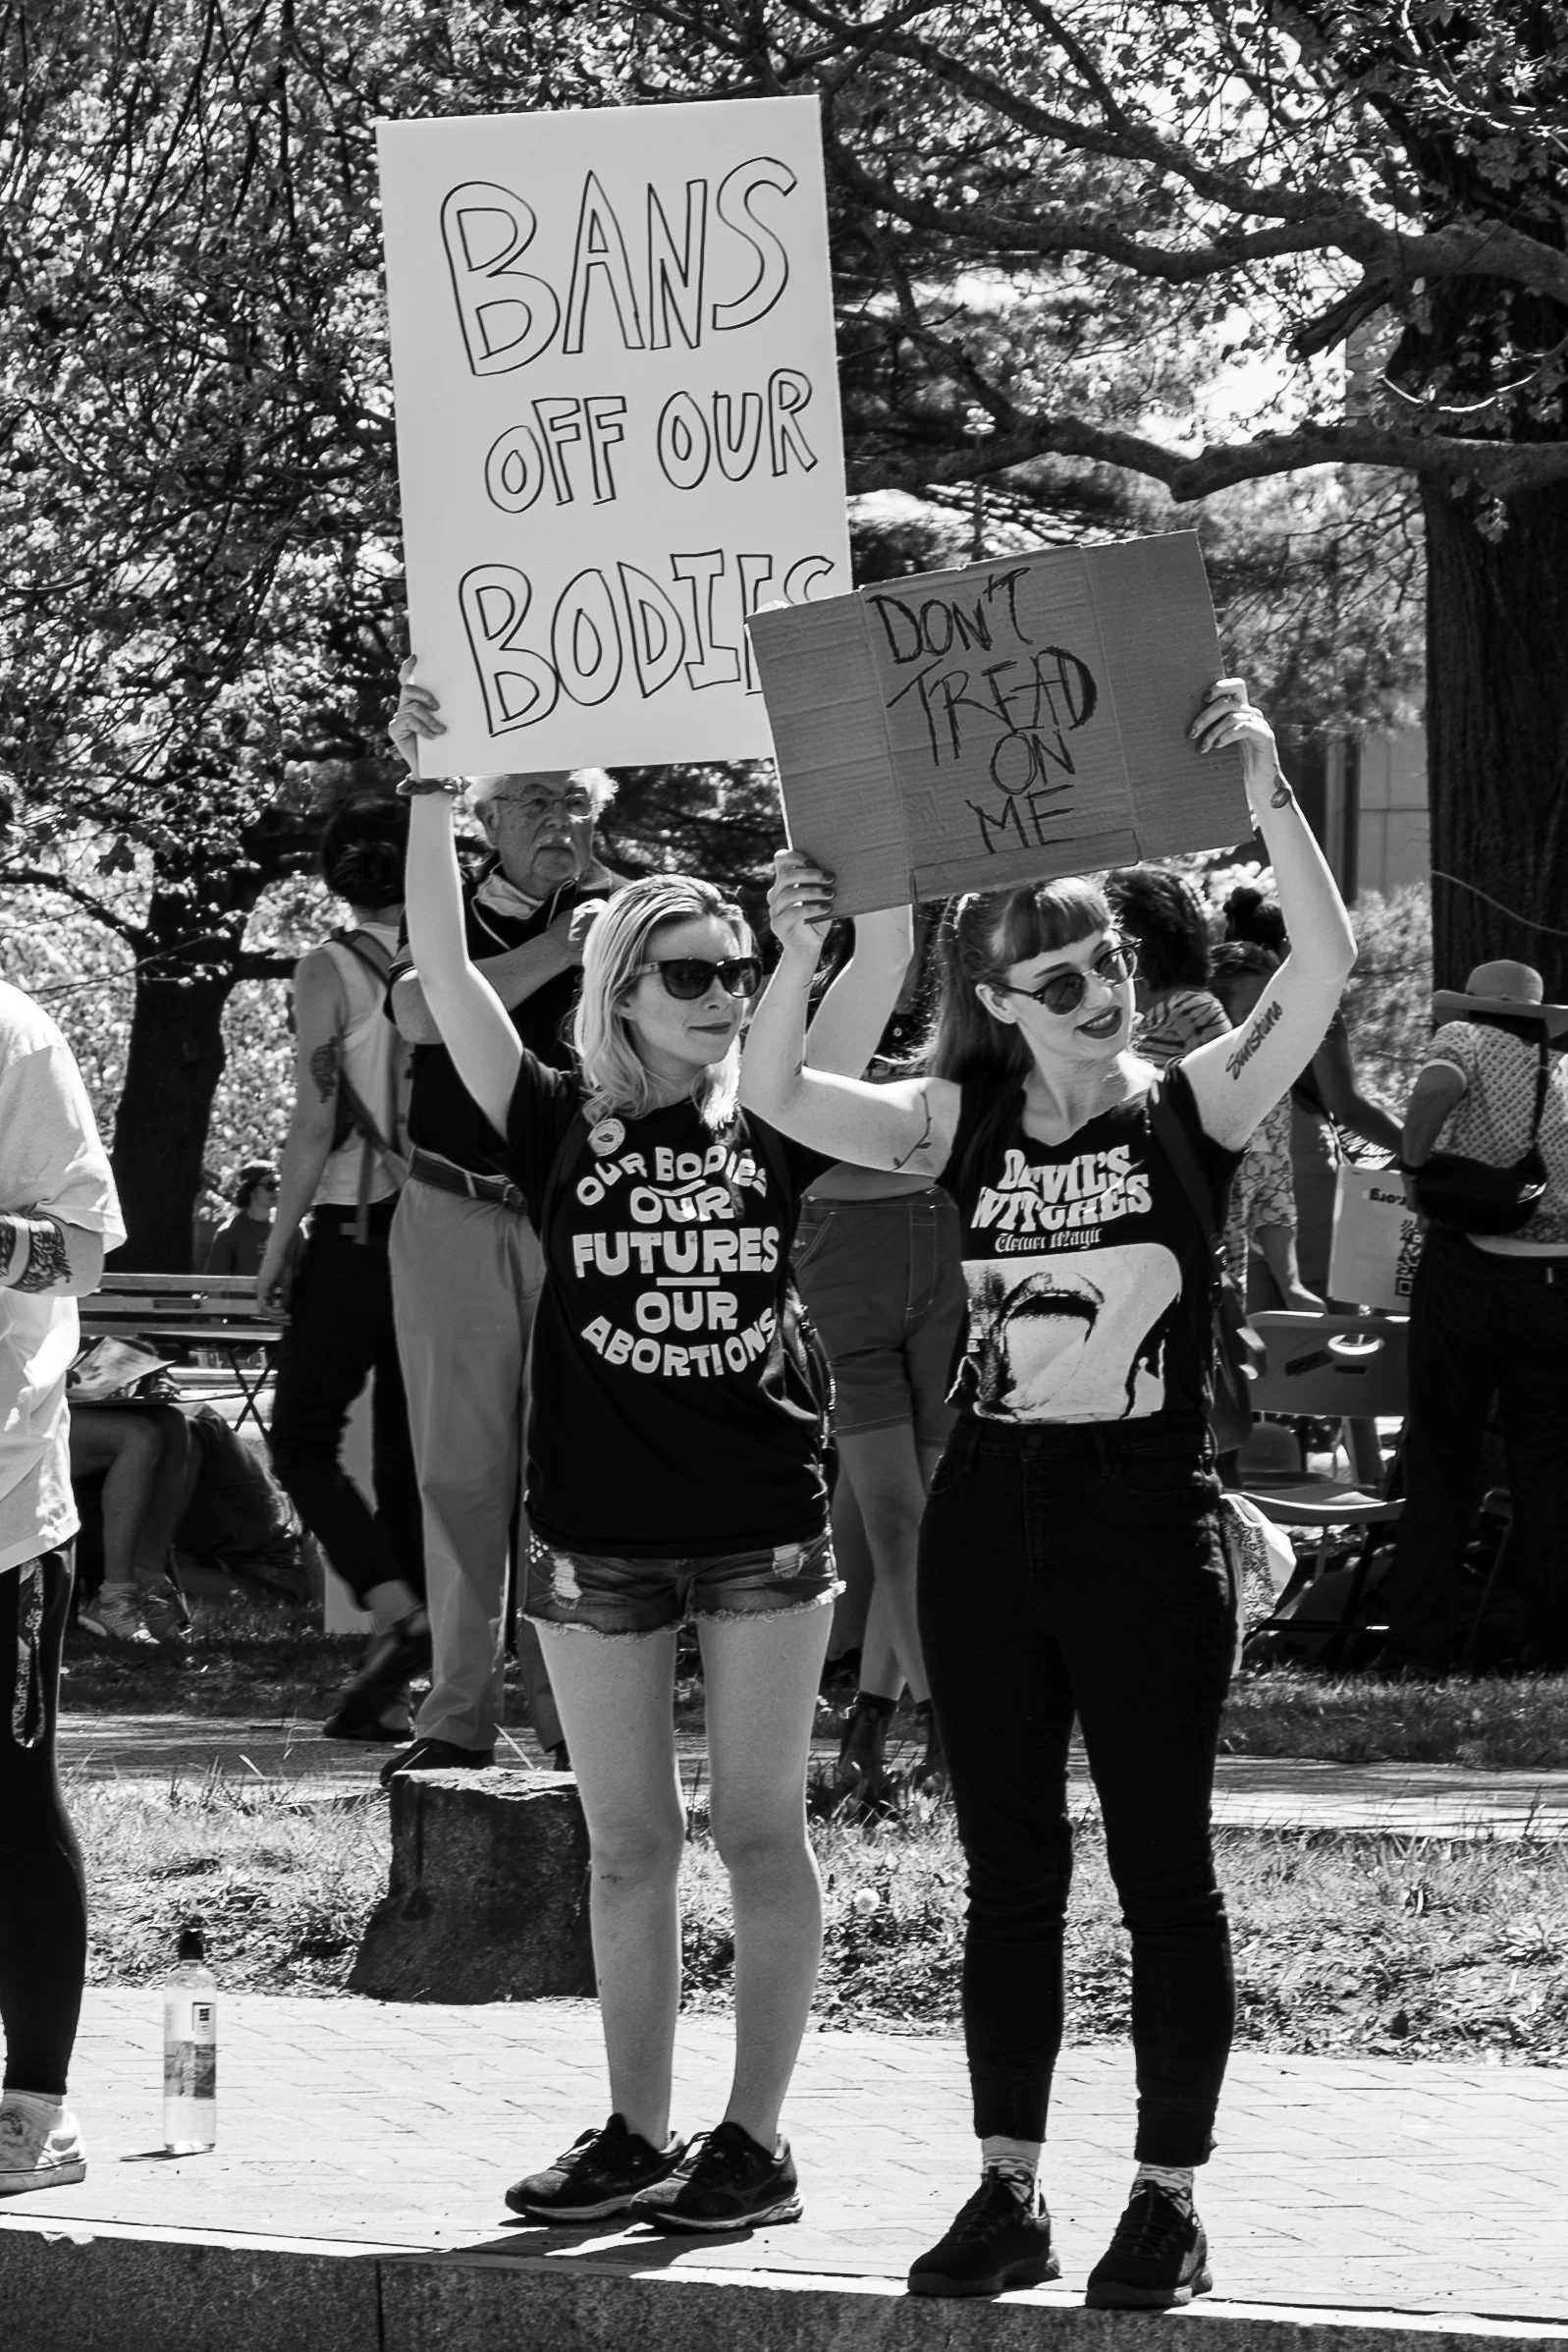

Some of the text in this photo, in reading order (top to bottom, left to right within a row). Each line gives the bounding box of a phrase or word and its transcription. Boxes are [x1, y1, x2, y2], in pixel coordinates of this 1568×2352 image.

[440, 156, 797, 376] BANS
[485, 368, 817, 514] OFF OUR
[865, 567, 1033, 665] DON'T
[886, 645, 1099, 767] TREAD
[990, 728, 1076, 795] ON
[964, 784, 1076, 854] ME
[576, 1145, 767, 1206] OUR BODIES
[630, 1185, 735, 1224] OUR
[572, 1226, 780, 1279] FUTURES
[580, 1307, 778, 1378] ABORTIONS
[635, 1290, 737, 1334] OUR
